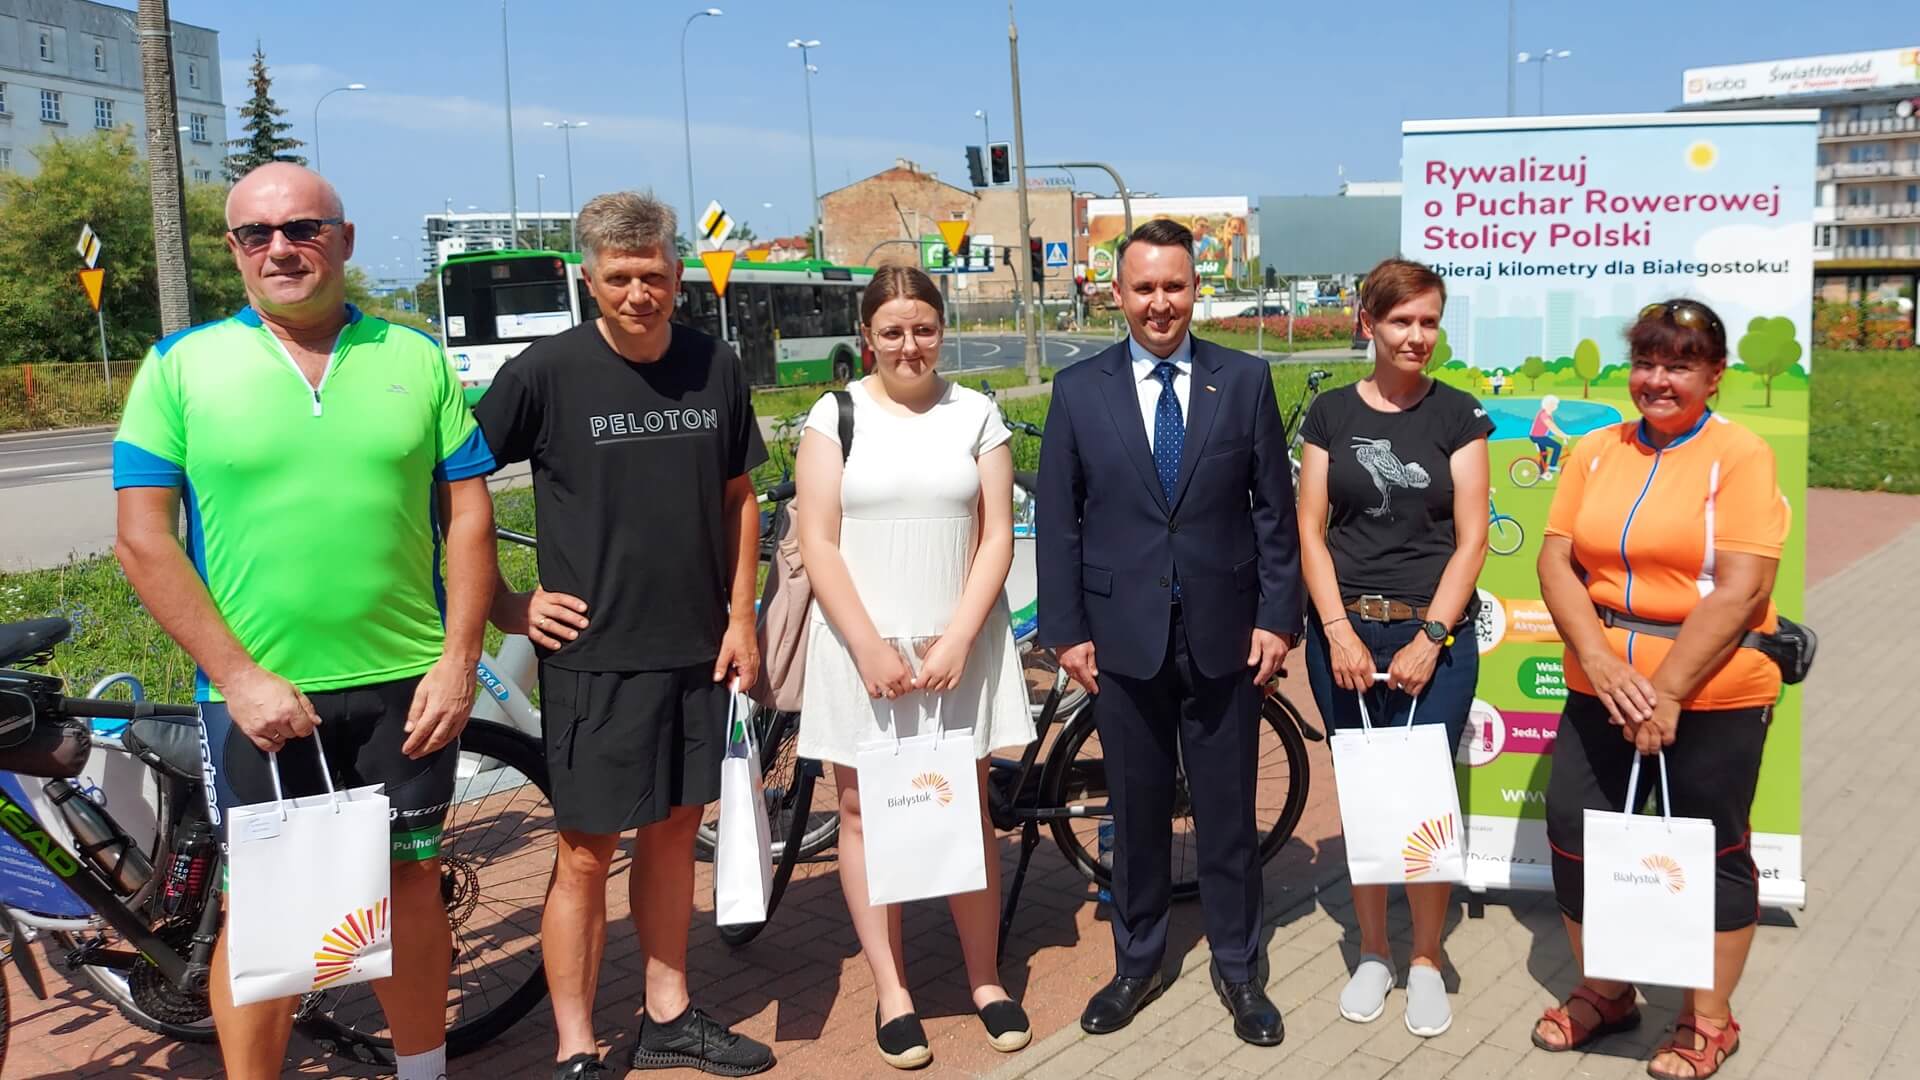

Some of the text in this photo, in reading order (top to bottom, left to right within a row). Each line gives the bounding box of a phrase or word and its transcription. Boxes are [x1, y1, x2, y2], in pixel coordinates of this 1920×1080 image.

[1768, 59, 1873, 84] Światłowód
[1425, 156, 1587, 189] Rywalizuj
[1424, 186, 1781, 218] o Puchar Rowerowej
[1423, 220, 1651, 254] Stolicy Polski
[1499, 261, 1597, 279] kilometry
[1604, 259, 1635, 275] dla
[1643, 259, 1789, 278] Białegostoku!
[590, 408, 718, 437] PELOTON
[477, 663, 496, 687] 626
[0, 795, 78, 877] EAD
